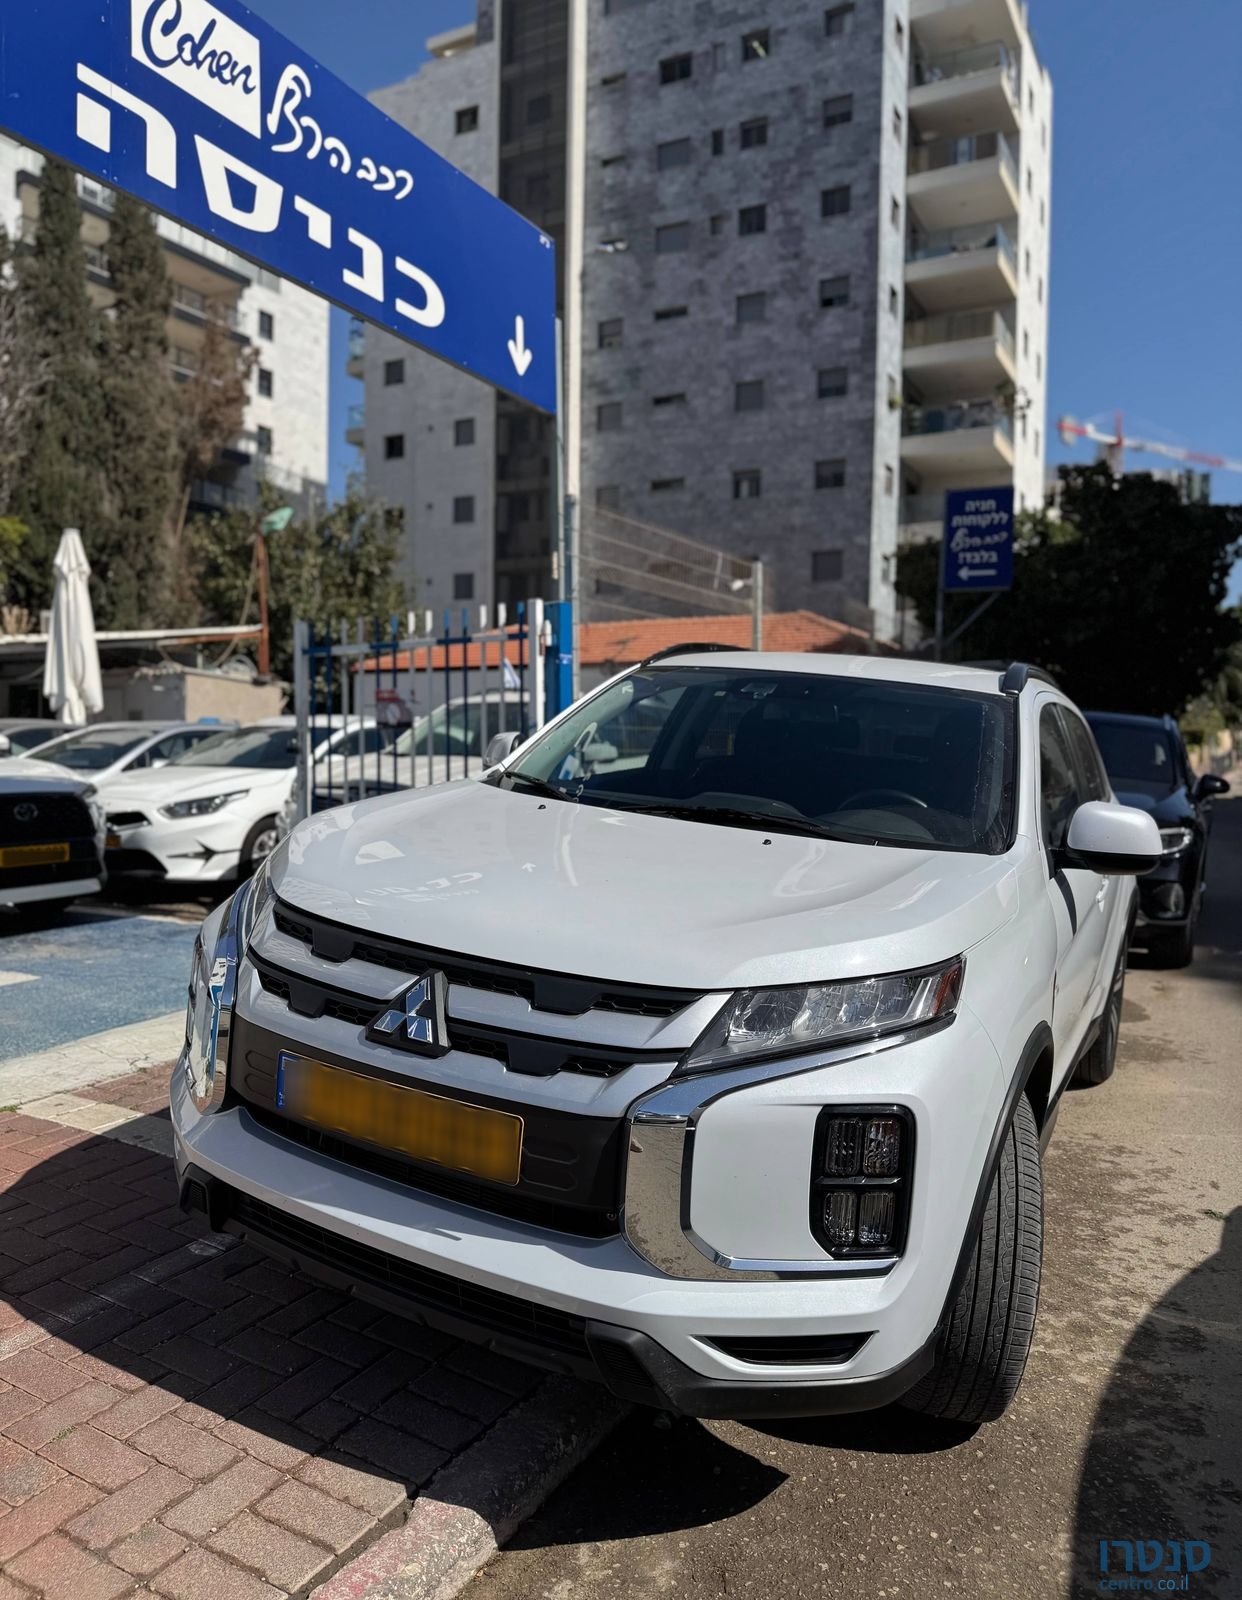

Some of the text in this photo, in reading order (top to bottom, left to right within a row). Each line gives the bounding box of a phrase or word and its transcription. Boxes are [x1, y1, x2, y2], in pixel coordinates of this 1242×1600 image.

[142, 0, 256, 94] Cohen
[77, 62, 445, 328] כניסה
[356, 157, 414, 200] רכב
[951, 511, 1008, 528] ללקוחות
[965, 499, 996, 513] חניה
